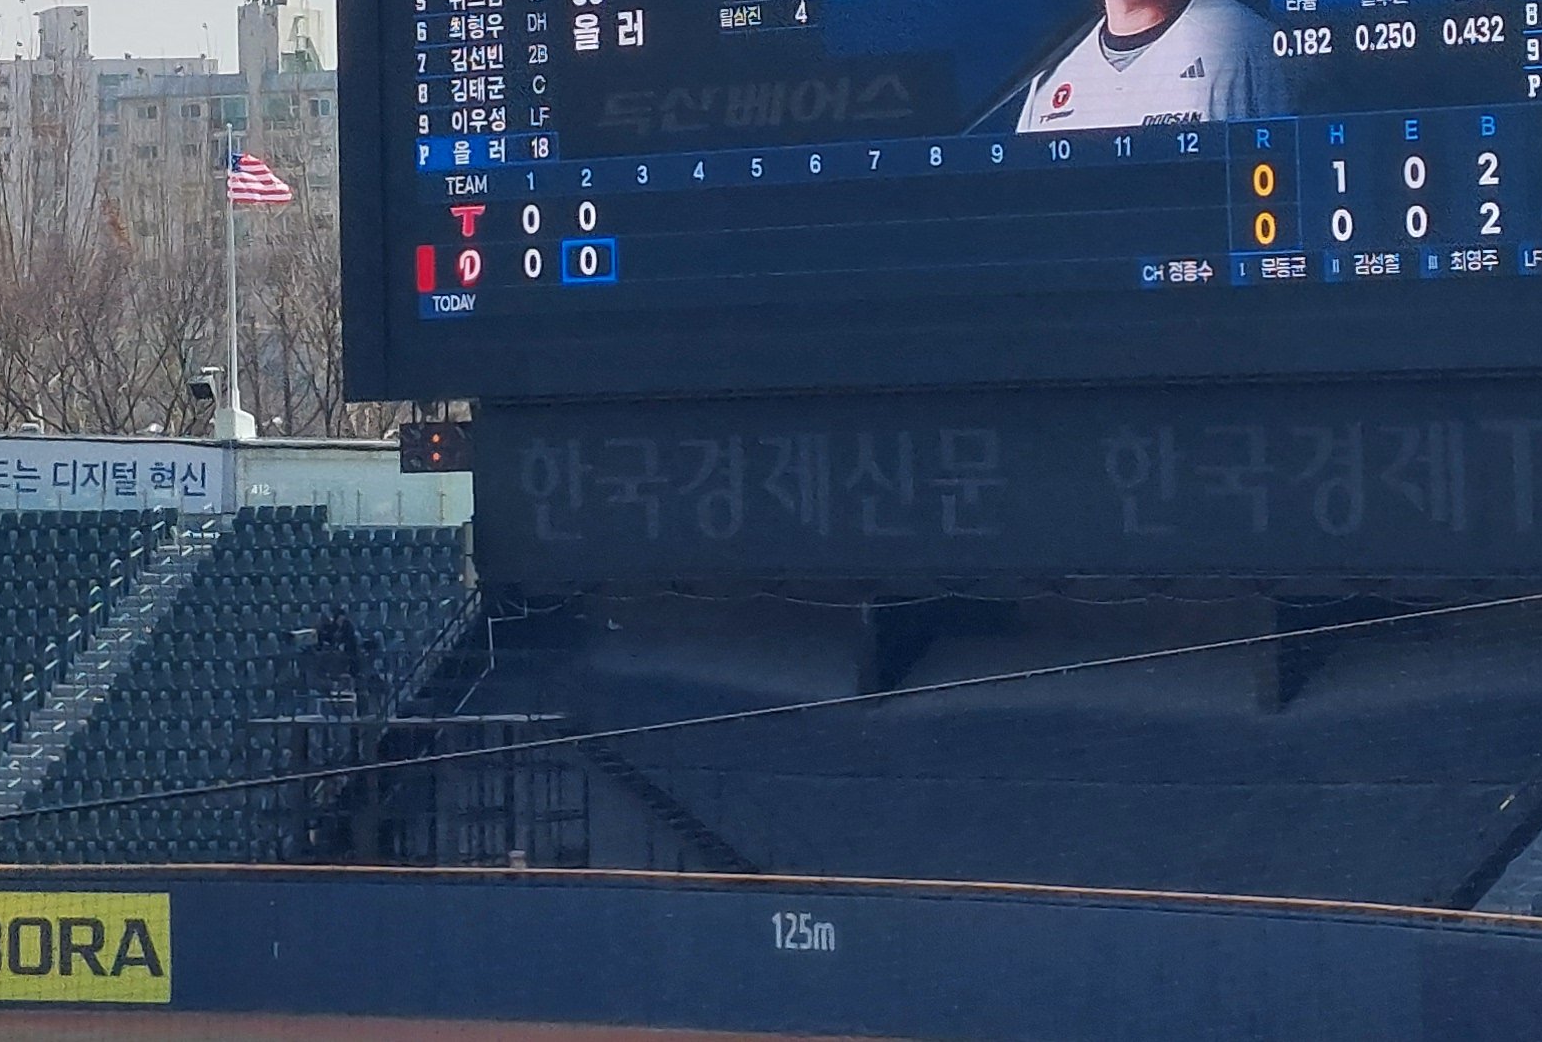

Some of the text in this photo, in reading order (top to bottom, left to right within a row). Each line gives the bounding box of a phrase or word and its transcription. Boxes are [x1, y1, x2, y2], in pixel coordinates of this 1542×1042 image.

[795, 0, 807, 22] 4
[449, 13, 546, 40] 최형우 DH
[1273, 16, 1504, 56] 0.182 0.250 0.432
[451, 44, 548, 72] 김선빈 2B
[451, 75, 546, 102] 김태군 C
[452, 107, 549, 134] 이우성 LF
[1256, 116, 1496, 148] R H E B
[532, 136, 549, 158] 18
[445, 133, 1198, 195] TEAM 10 11 12
[523, 153, 1499, 234] 0 0 0 1 0 2
[525, 202, 1501, 277] 0 0 0 0 0 2
[1451, 250, 1498, 271] 최영주
[1524, 250, 1542, 266] LF
[432, 294, 475, 312] TODAY
[52, 460, 137, 501] 디지털
[520, 430, 1010, 540] 한국경제신문
[772, 912, 835, 951] 125m
